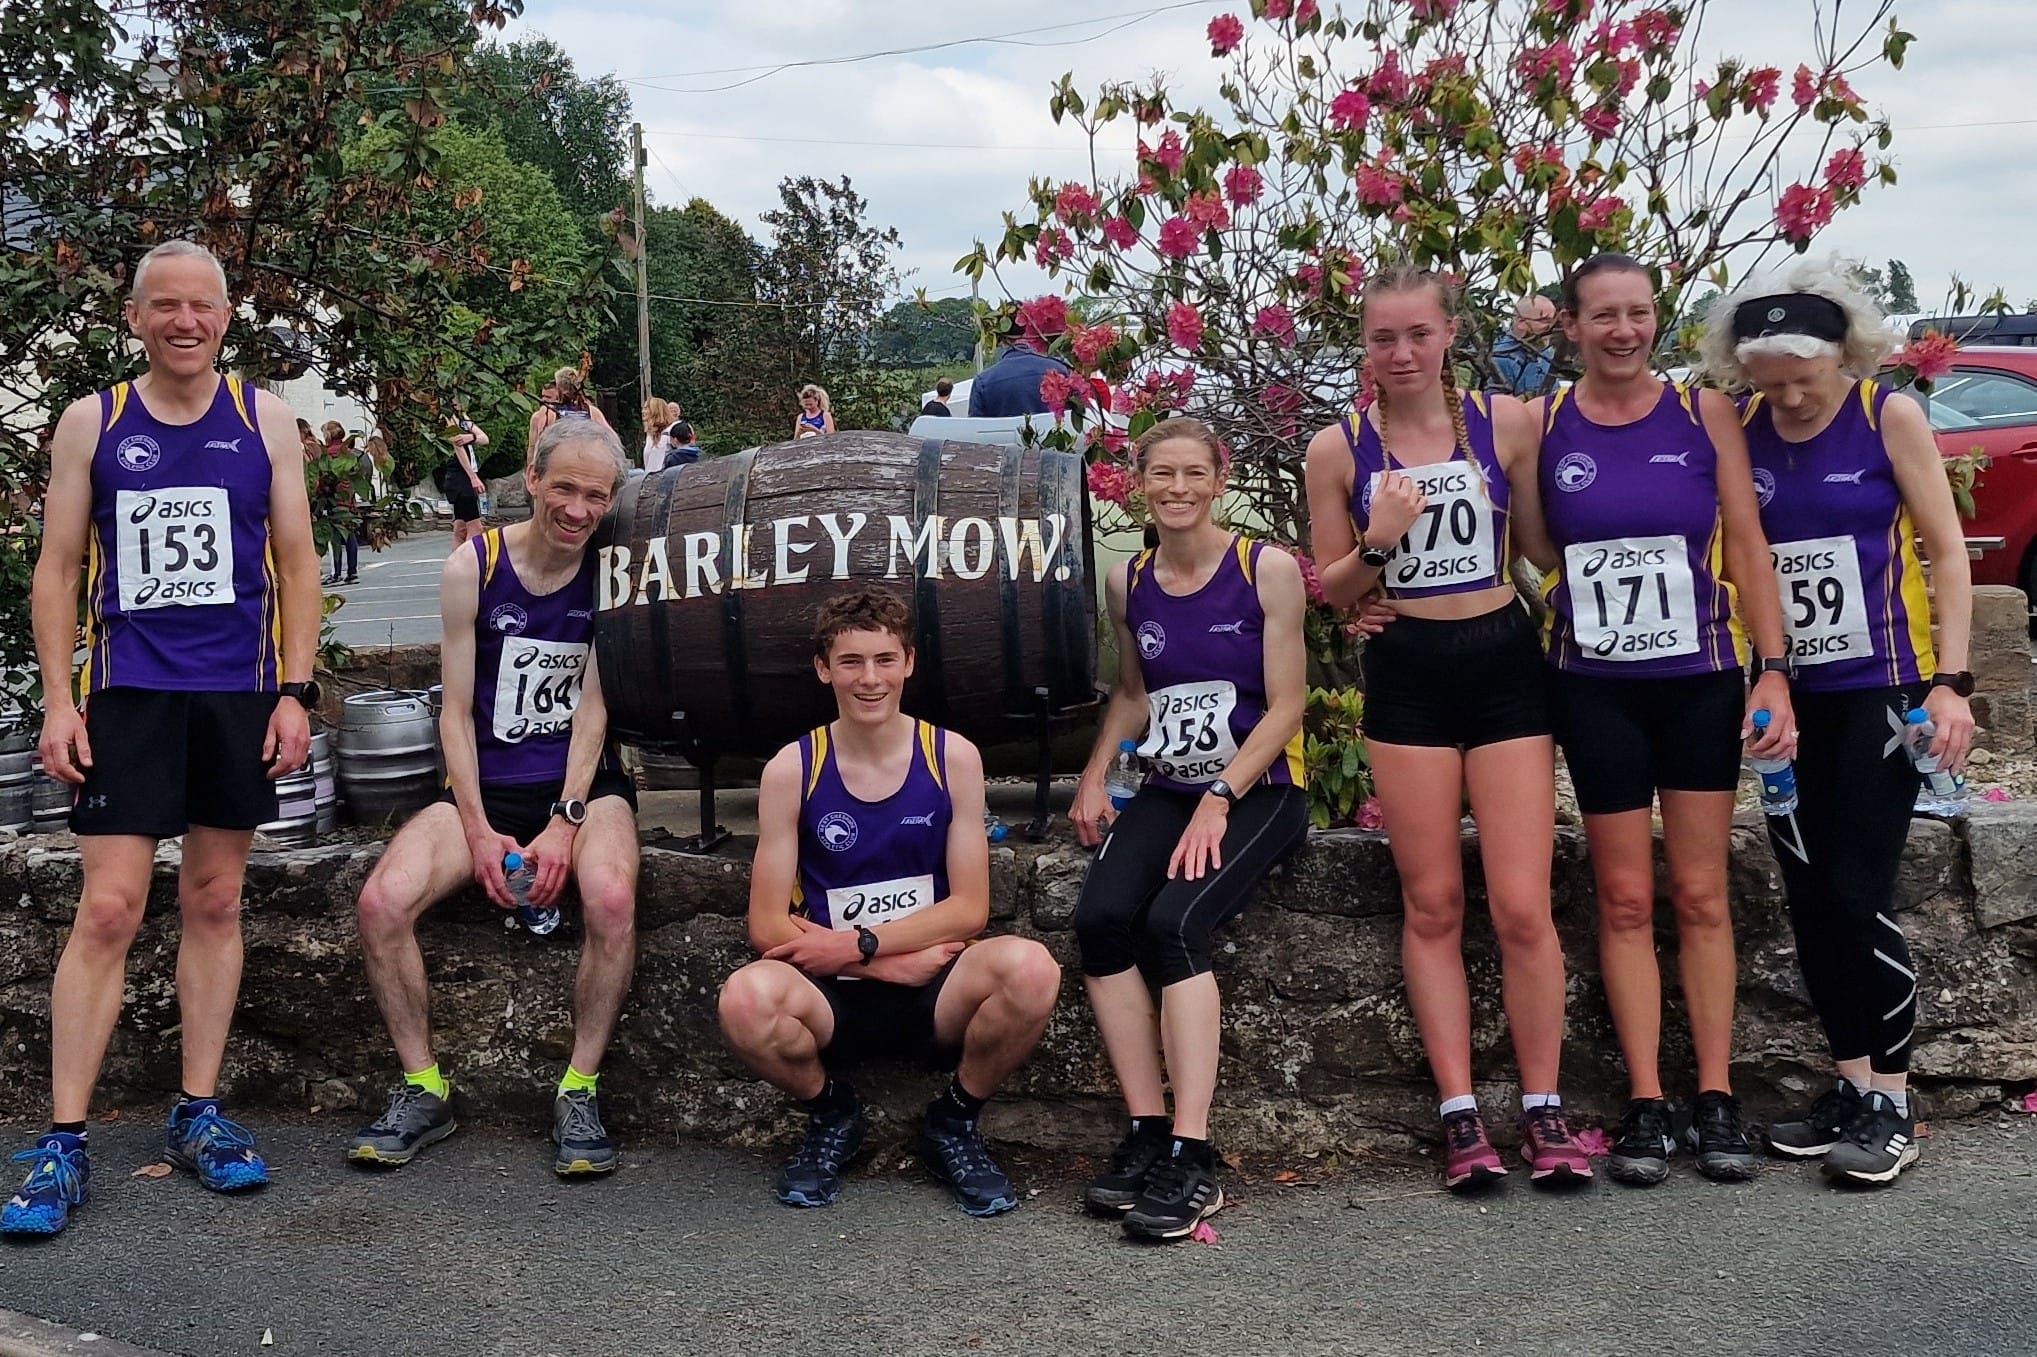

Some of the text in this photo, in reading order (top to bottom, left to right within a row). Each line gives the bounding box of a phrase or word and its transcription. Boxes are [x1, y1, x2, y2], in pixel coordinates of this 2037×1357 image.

[158, 500, 213, 519] asics
[139, 524, 219, 575] 153
[598, 512, 1071, 611] BARLEY MOW.
[1611, 548, 1666, 570] asics
[1423, 554, 1478, 578] asics
[1781, 551, 1836, 574] asics
[161, 581, 217, 599] asics
[1593, 572, 1671, 628] 171
[1621, 629, 1678, 653] asics
[1795, 633, 1850, 657] asics
[538, 653, 583, 669] asics
[514, 674, 575, 716] 164
[1171, 692, 1220, 714] asics
[531, 720, 573, 736] asic
[1154, 711, 1219, 760] 158
[1178, 757, 1225, 779] asics
[867, 889, 918, 915] asics
